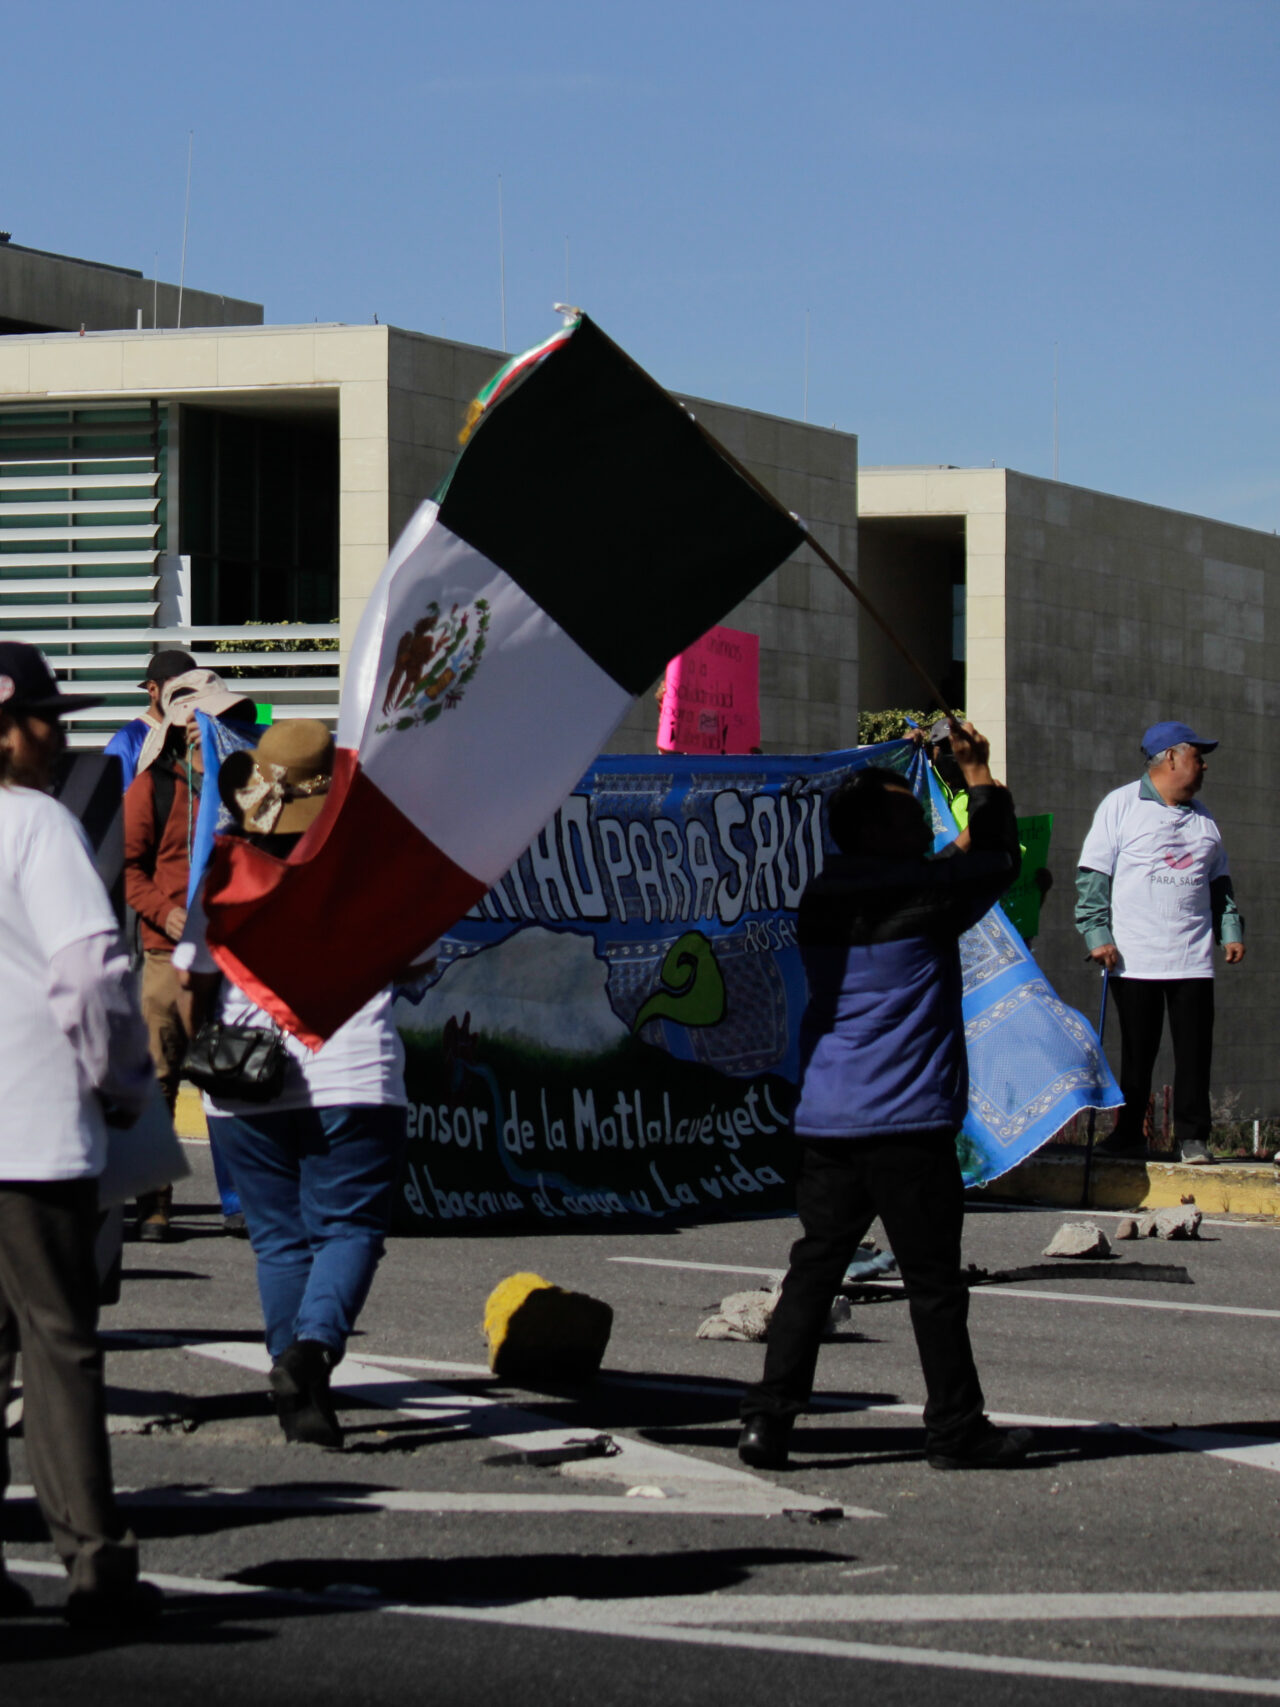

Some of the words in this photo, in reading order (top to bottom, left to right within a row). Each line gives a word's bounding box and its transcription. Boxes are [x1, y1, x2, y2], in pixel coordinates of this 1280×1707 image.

[596, 816, 719, 924] PARA
[744, 918, 798, 952] ROSA
[406, 1103, 489, 1151] ensor
[503, 1090, 536, 1155] de
[541, 1087, 568, 1151] la
[700, 1153, 786, 1201] vida
